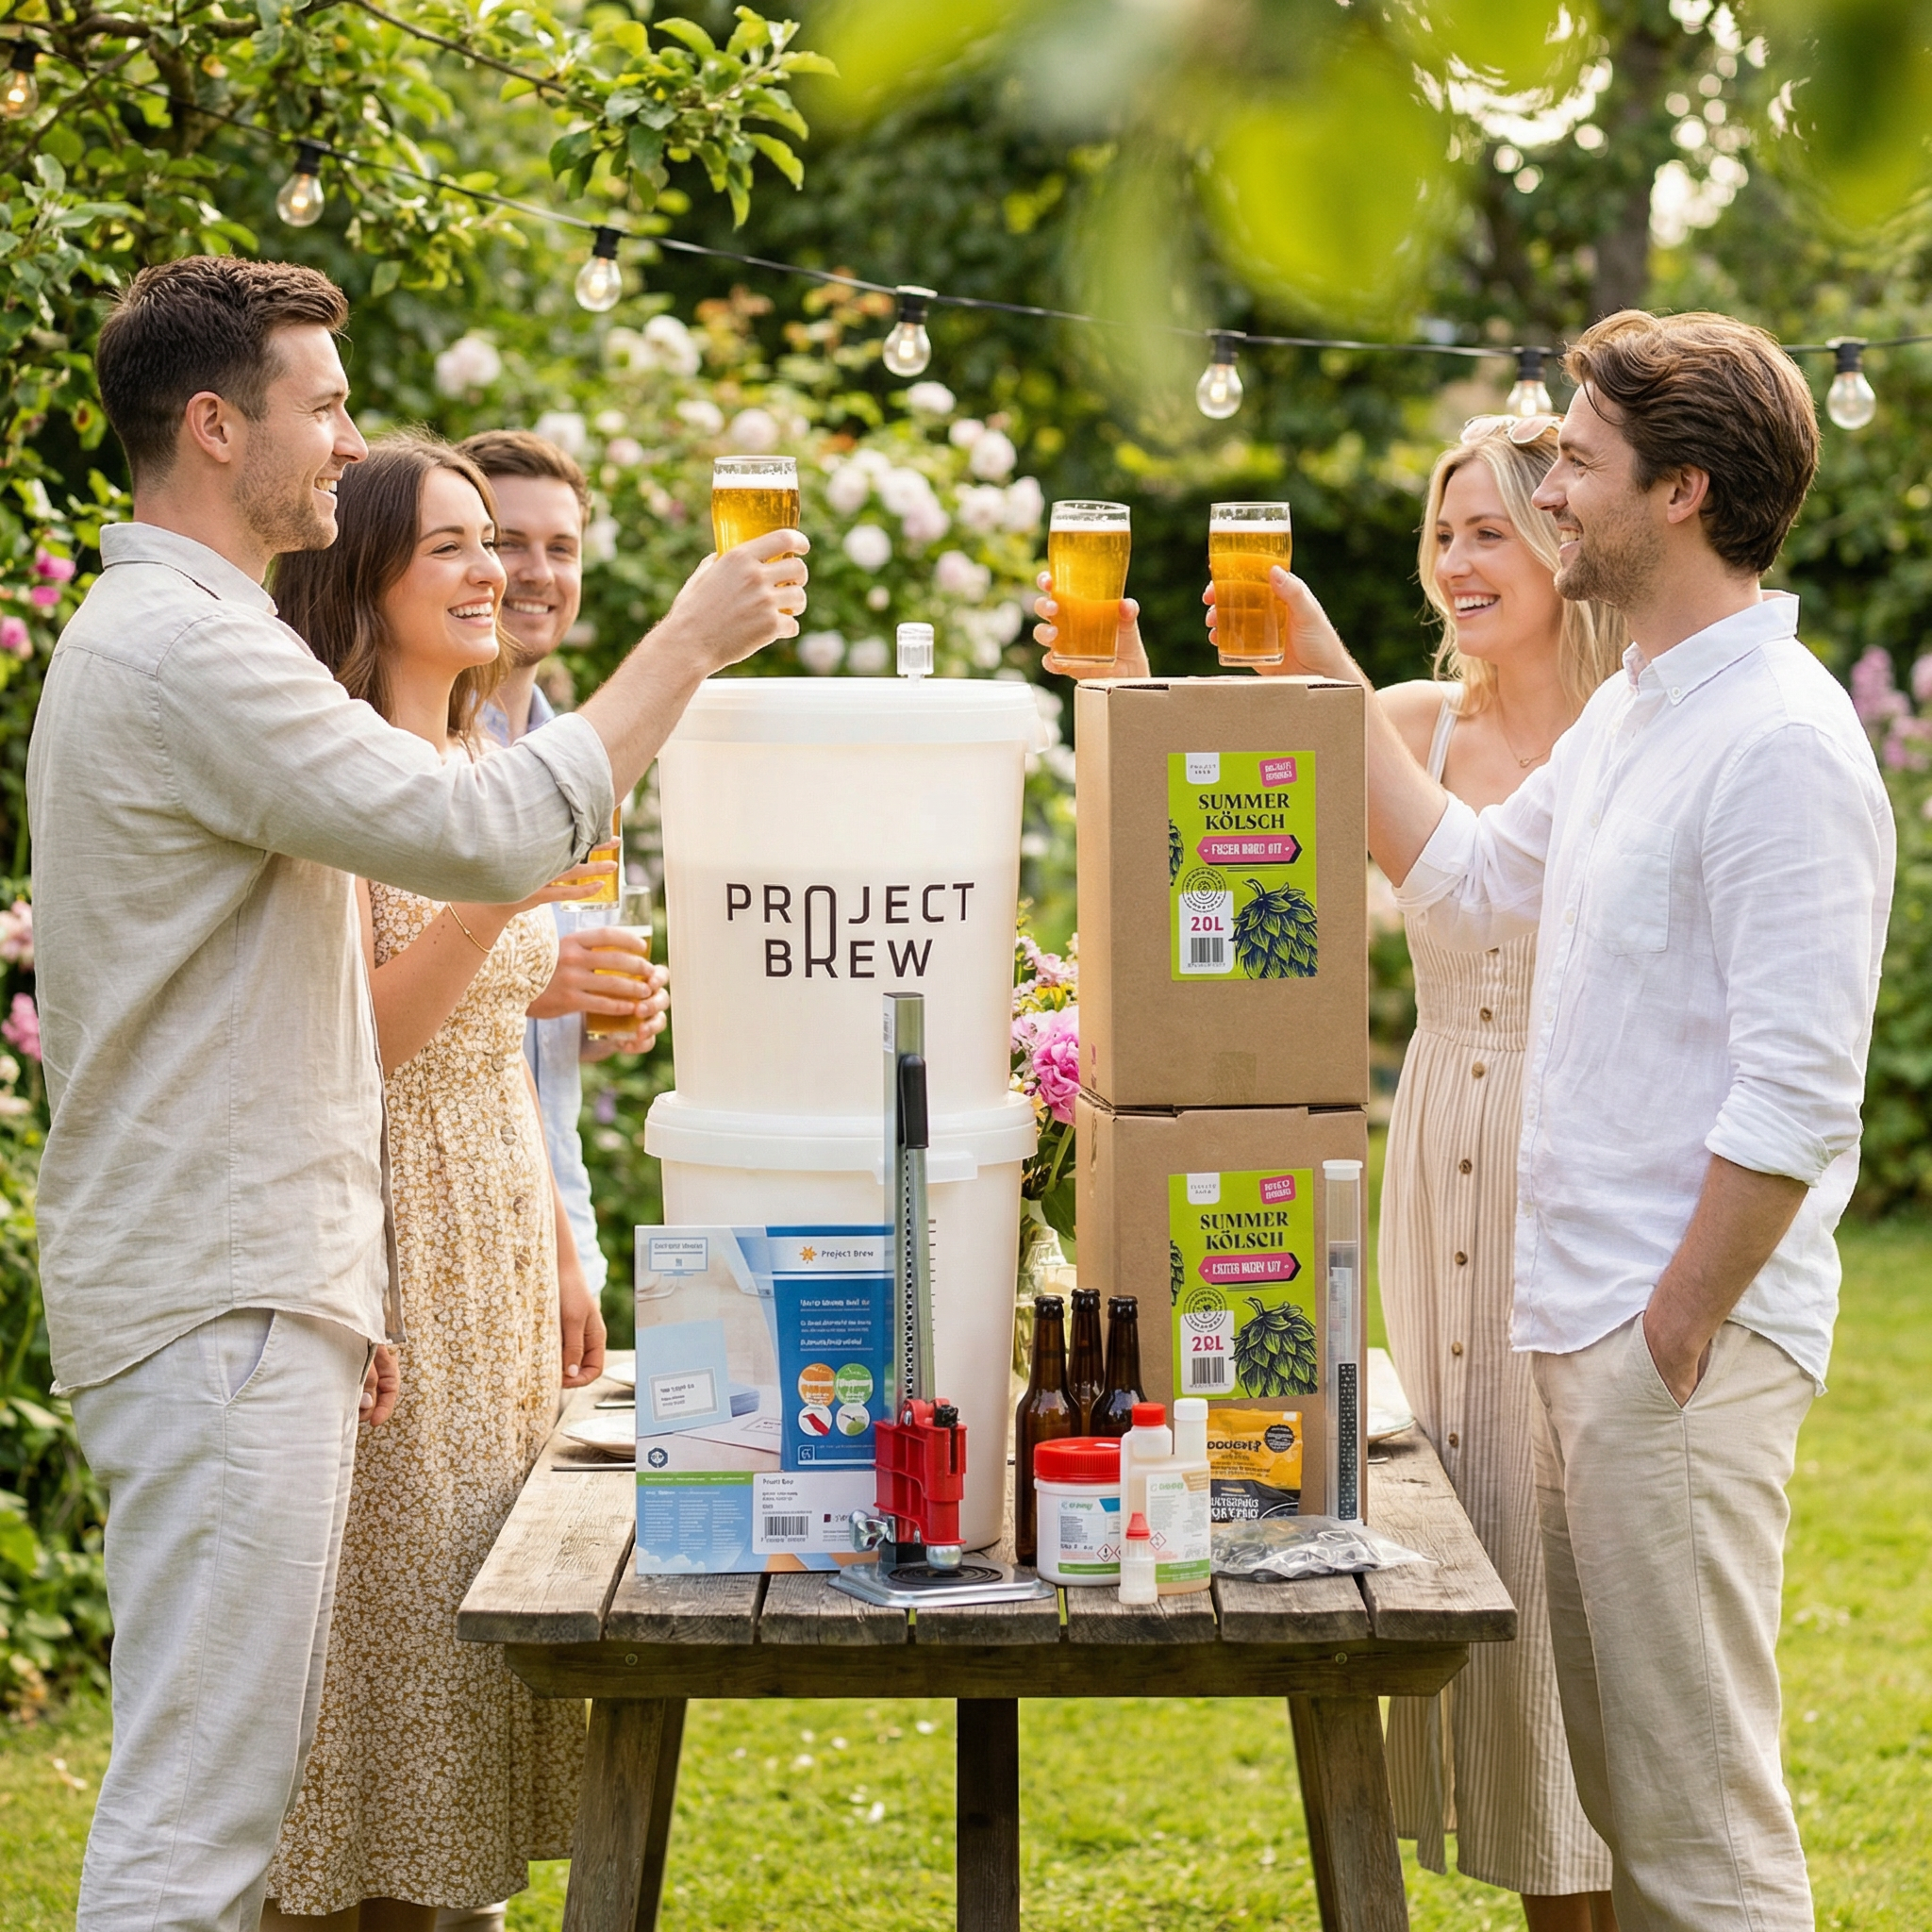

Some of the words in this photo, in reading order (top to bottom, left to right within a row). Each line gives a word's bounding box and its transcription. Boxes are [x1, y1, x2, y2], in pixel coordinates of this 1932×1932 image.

[1199, 793, 1291, 809] SUMMER
[1206, 810, 1285, 830] KÖLSCH
[725, 882, 975, 925] PROJECT
[1191, 916, 1224, 932] 20L
[765, 938, 933, 978] BREW
[1200, 1211, 1290, 1230] SUMMER
